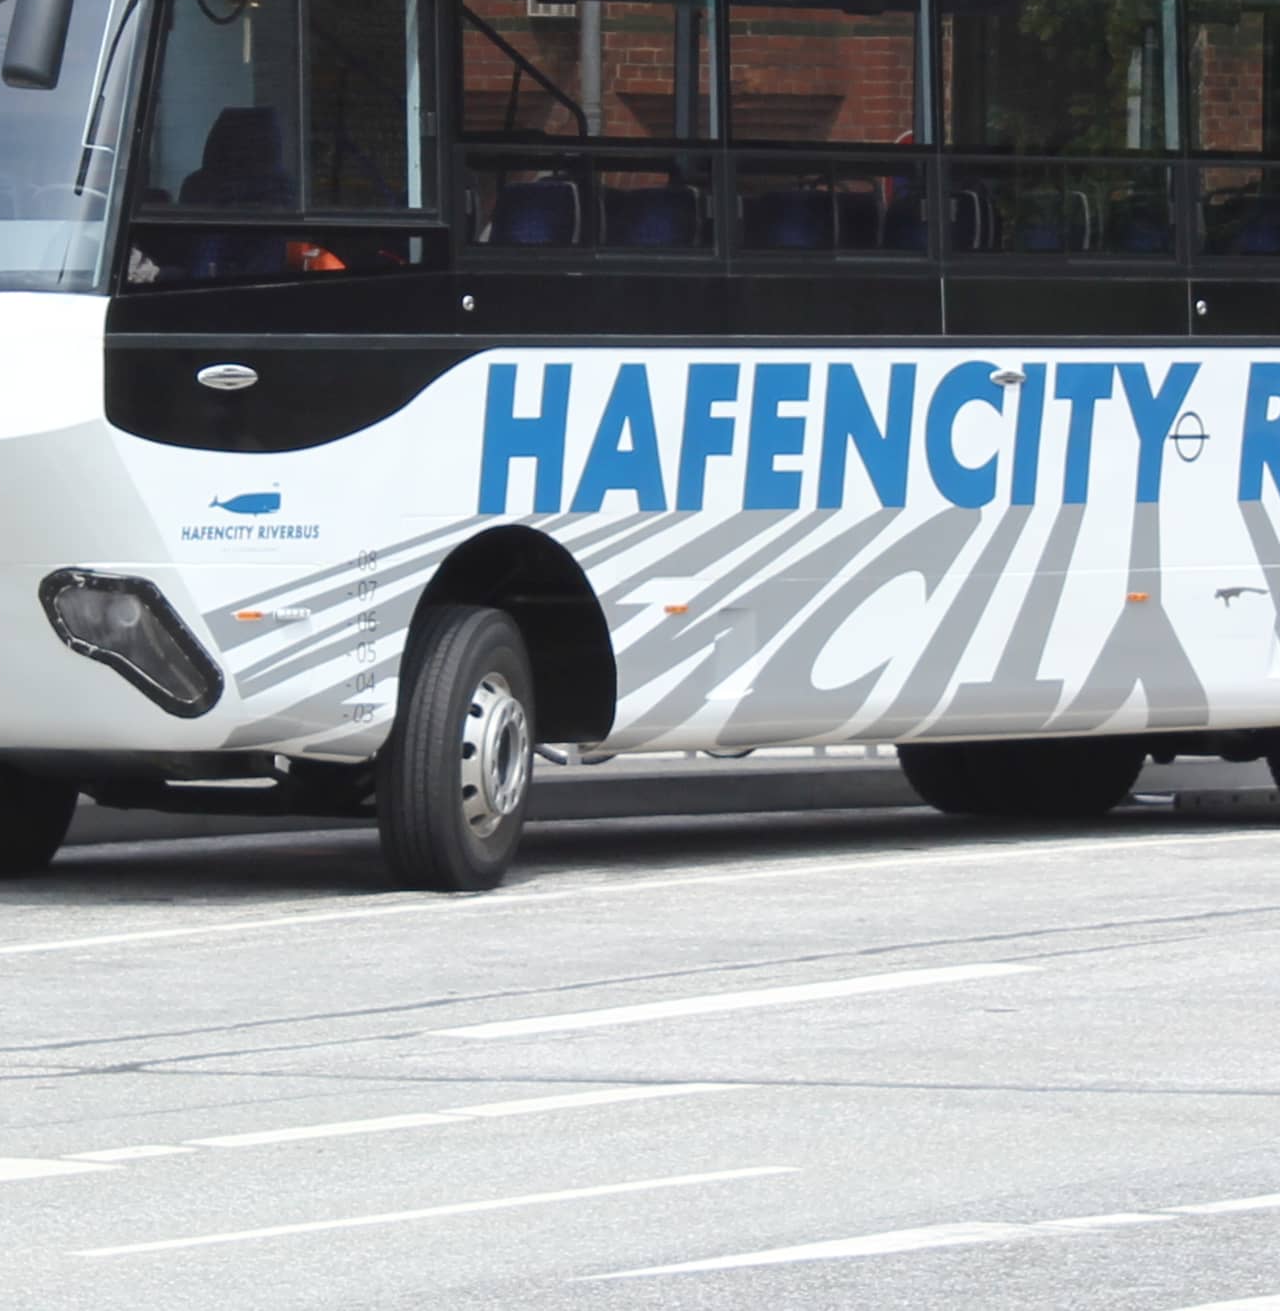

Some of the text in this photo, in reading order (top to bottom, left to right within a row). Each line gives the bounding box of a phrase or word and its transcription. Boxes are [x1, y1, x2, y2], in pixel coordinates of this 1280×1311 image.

[478, 360, 1202, 515] HAFENCITY
[181, 525, 319, 540] HAFENCITY RIVERBUS
